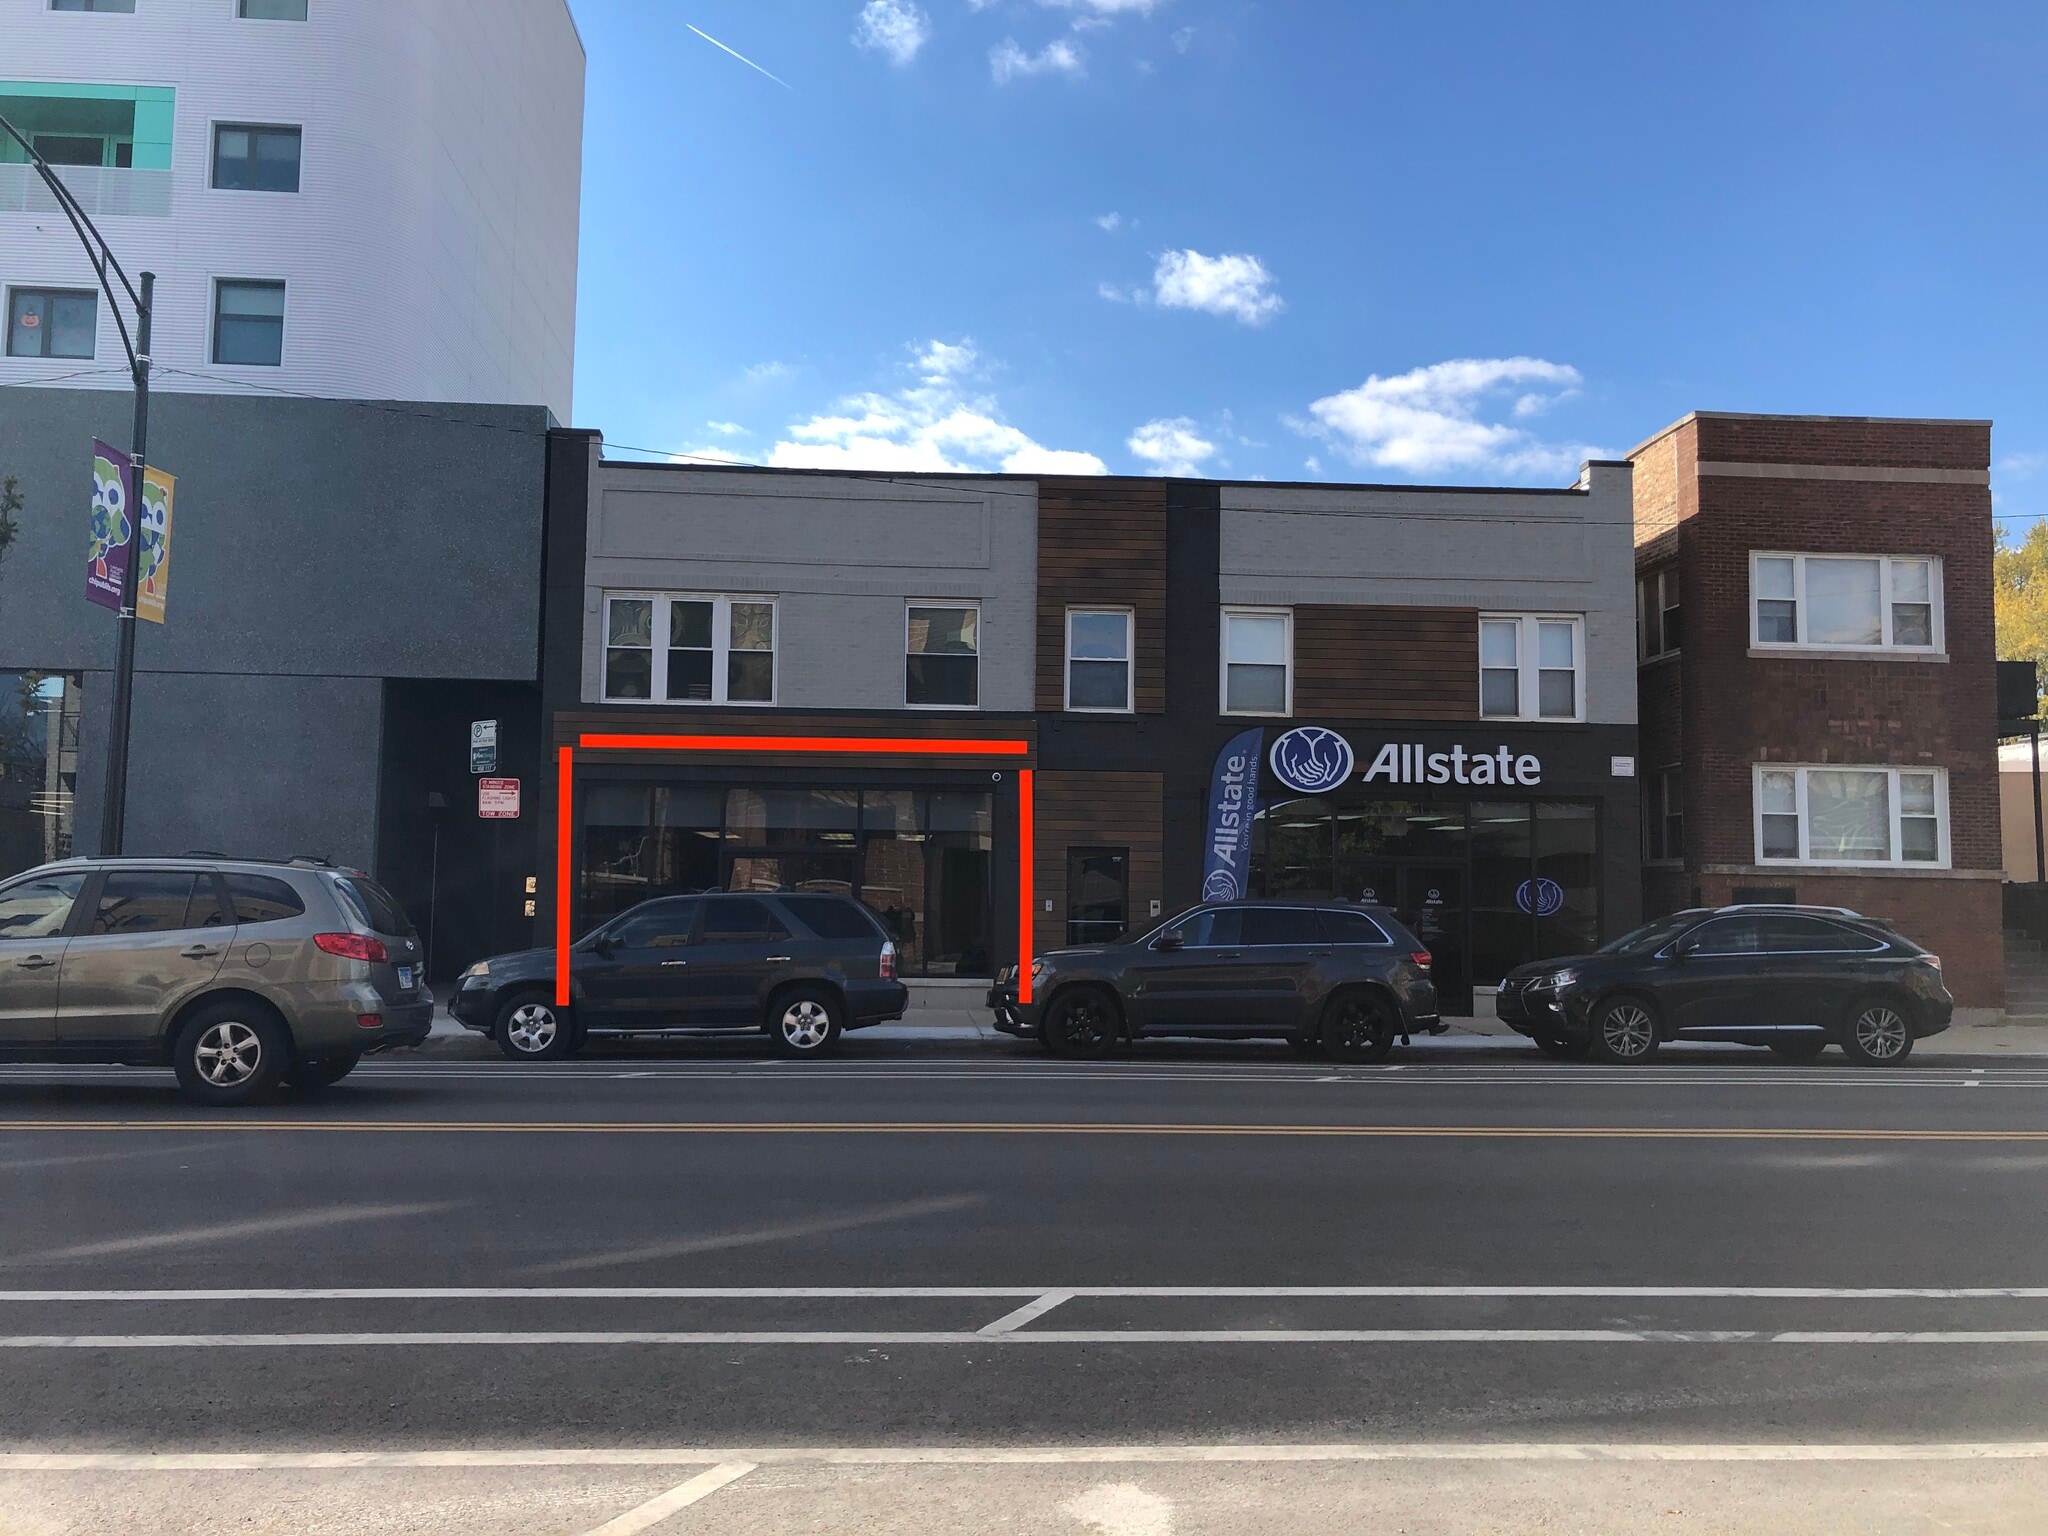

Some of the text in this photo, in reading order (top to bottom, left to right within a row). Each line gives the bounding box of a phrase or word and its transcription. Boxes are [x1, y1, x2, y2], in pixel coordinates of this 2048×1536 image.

[1247, 754, 1259, 785] hands.
[1362, 744, 1541, 786] Allstate
[1213, 756, 1246, 868] Allstate
[1247, 787, 1255, 811] good
